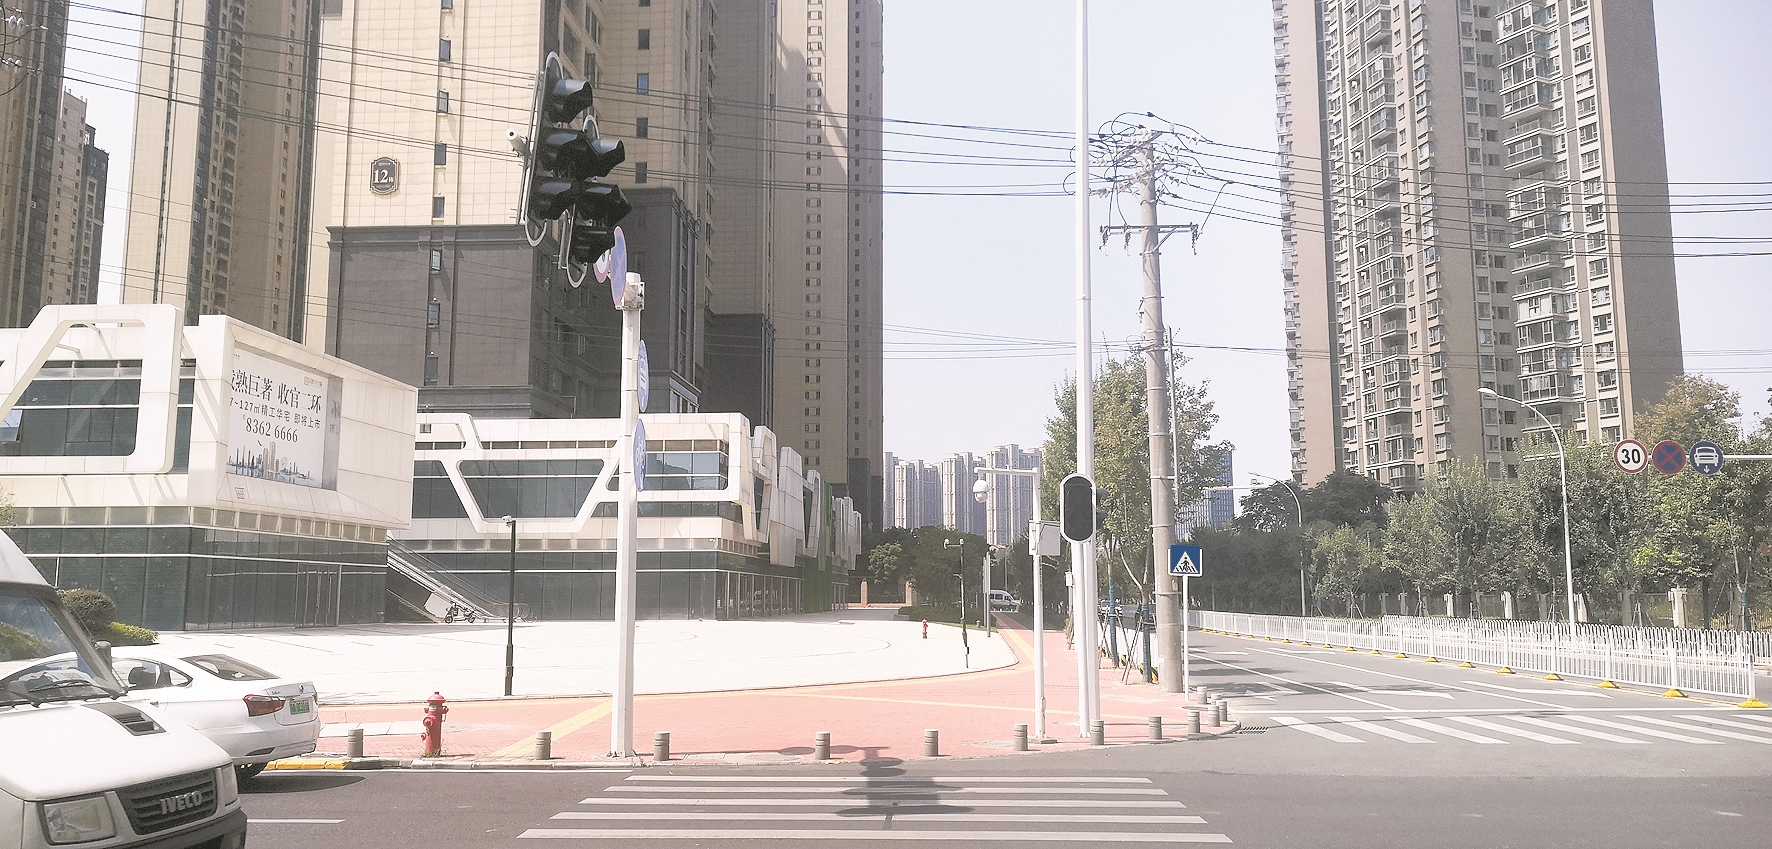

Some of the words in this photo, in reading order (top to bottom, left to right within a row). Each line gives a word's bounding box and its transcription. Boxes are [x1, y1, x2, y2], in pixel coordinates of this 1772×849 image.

[278, 383, 322, 414] 收官二环
[245, 417, 271, 437] 8362
[274, 424, 298, 443] 6666
[294, 413, 321, 430] 即将上市
[1621, 448, 1641, 464] 30
[159, 790, 202, 815] IVECO
